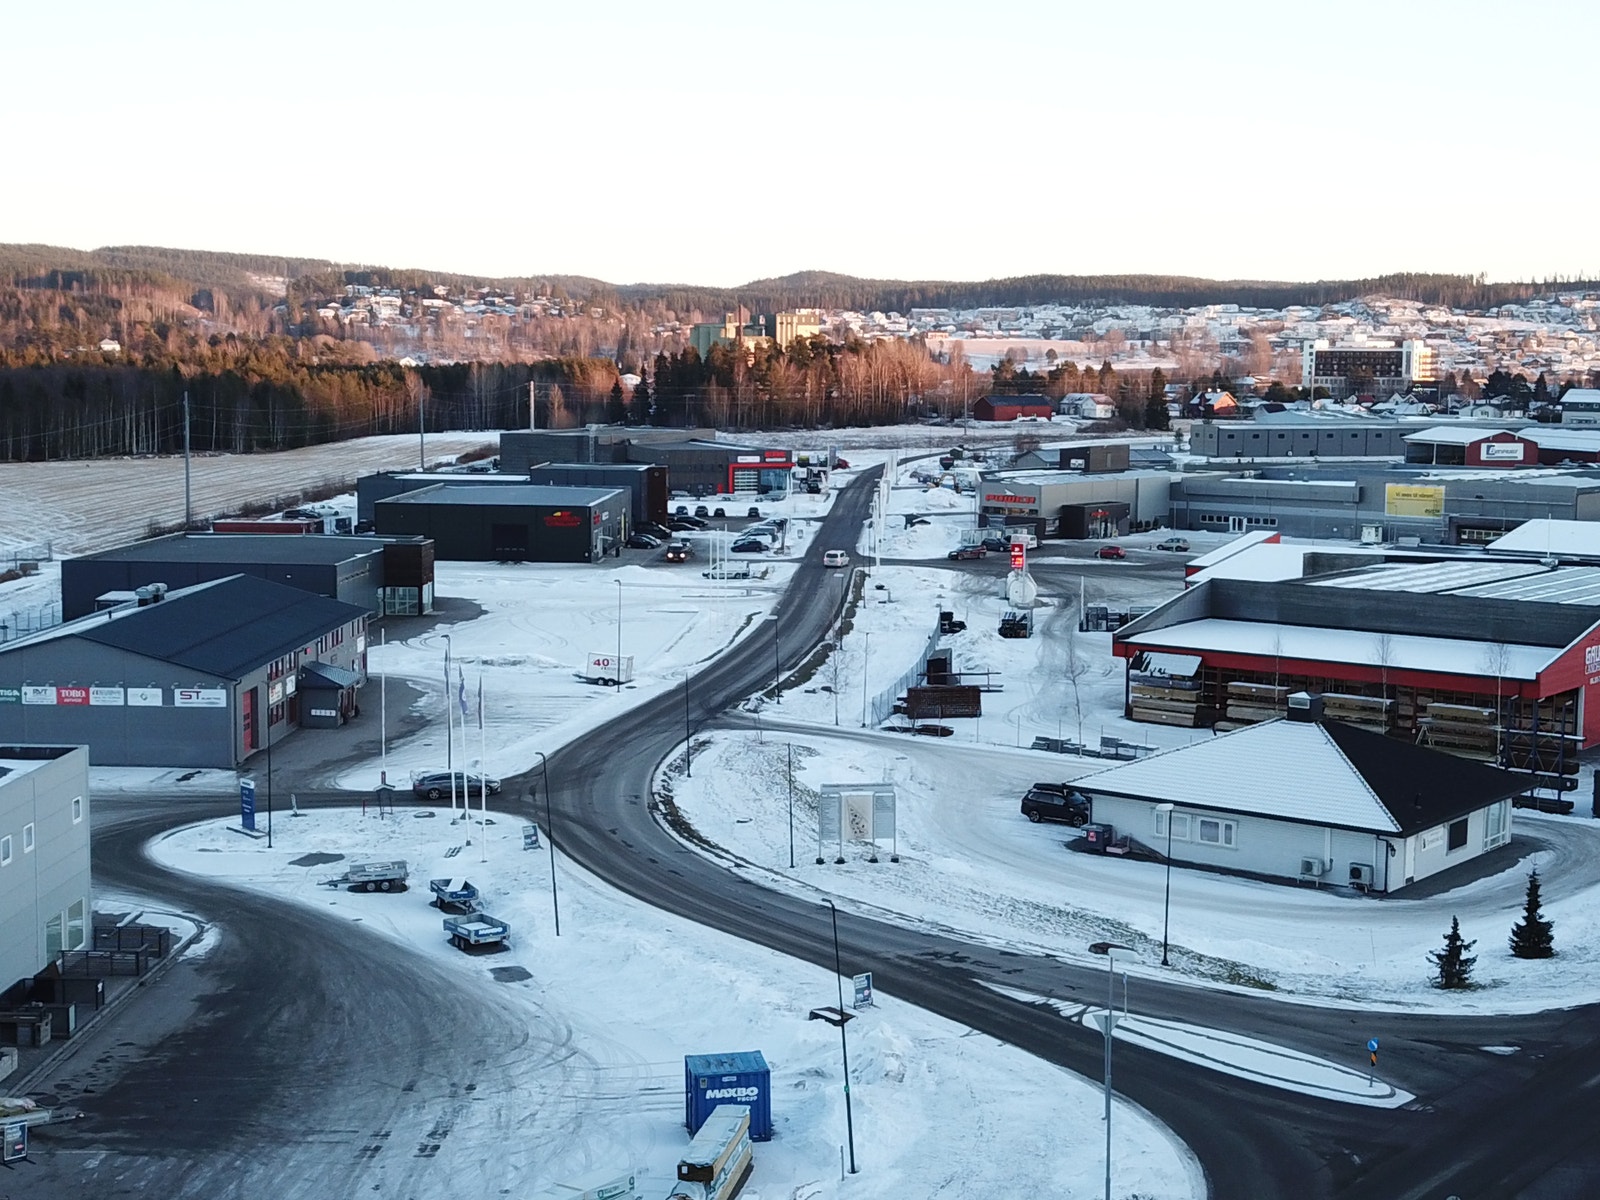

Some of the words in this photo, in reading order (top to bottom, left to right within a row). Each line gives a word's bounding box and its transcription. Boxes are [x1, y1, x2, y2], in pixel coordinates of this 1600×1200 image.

[593, 658, 610, 667] 40
[180, 690, 202, 700] ST
[705, 1086, 759, 1100] MAXBO
